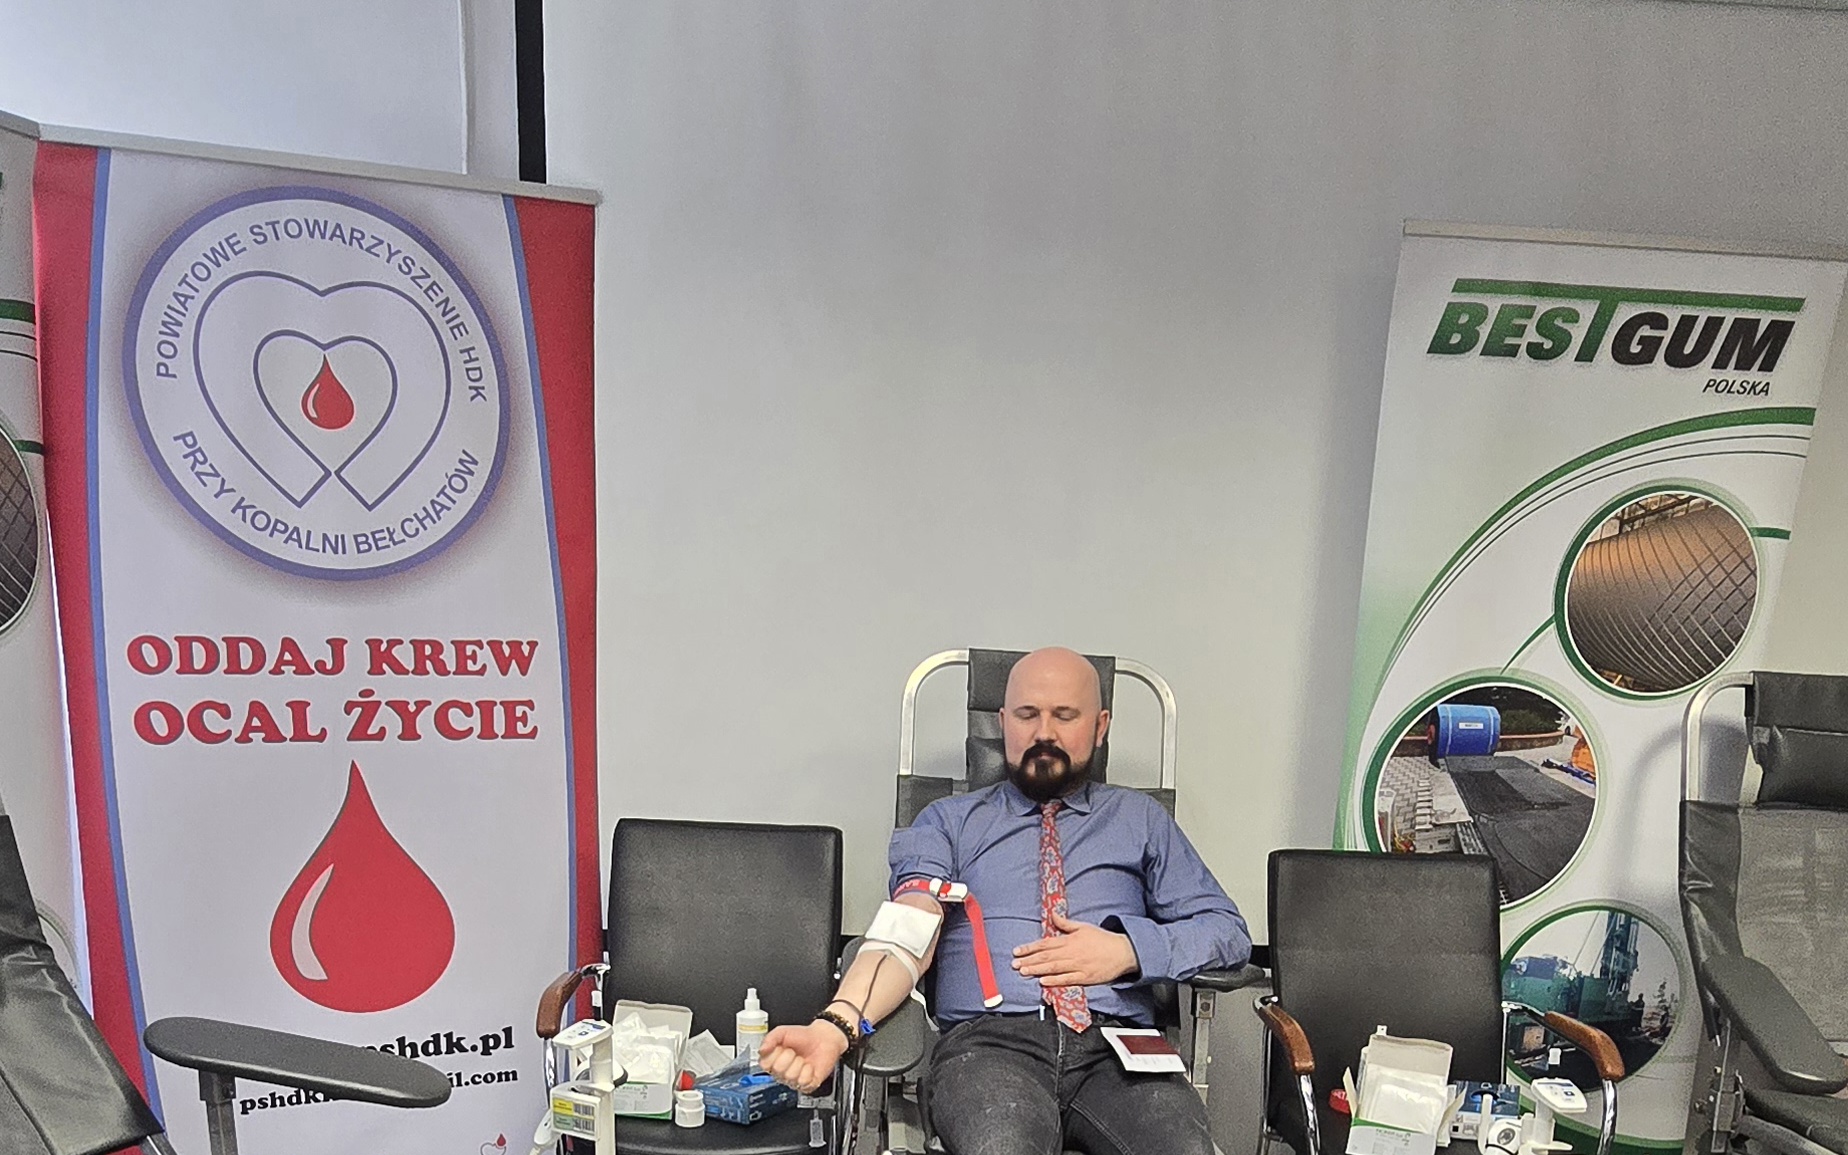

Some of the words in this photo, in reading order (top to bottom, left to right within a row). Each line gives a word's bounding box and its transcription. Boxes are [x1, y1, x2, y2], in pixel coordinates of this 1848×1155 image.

[155, 230, 247, 380] POWIATOWE
[248, 216, 469, 343] STOWARZYSZENIE
[457, 345, 488, 404] HDK
[1427, 278, 1806, 374] BESTGUM
[1702, 377, 1771, 397] POLSKA
[172, 430, 236, 501] PRZY
[230, 495, 348, 556] KOPALNI
[353, 448, 480, 557] BEŁCHATÓW
[126, 633, 348, 677] ODDAJ
[364, 637, 539, 677] KREW
[132, 698, 328, 746] OCAL
[342, 688, 540, 743] ŻYCIE
